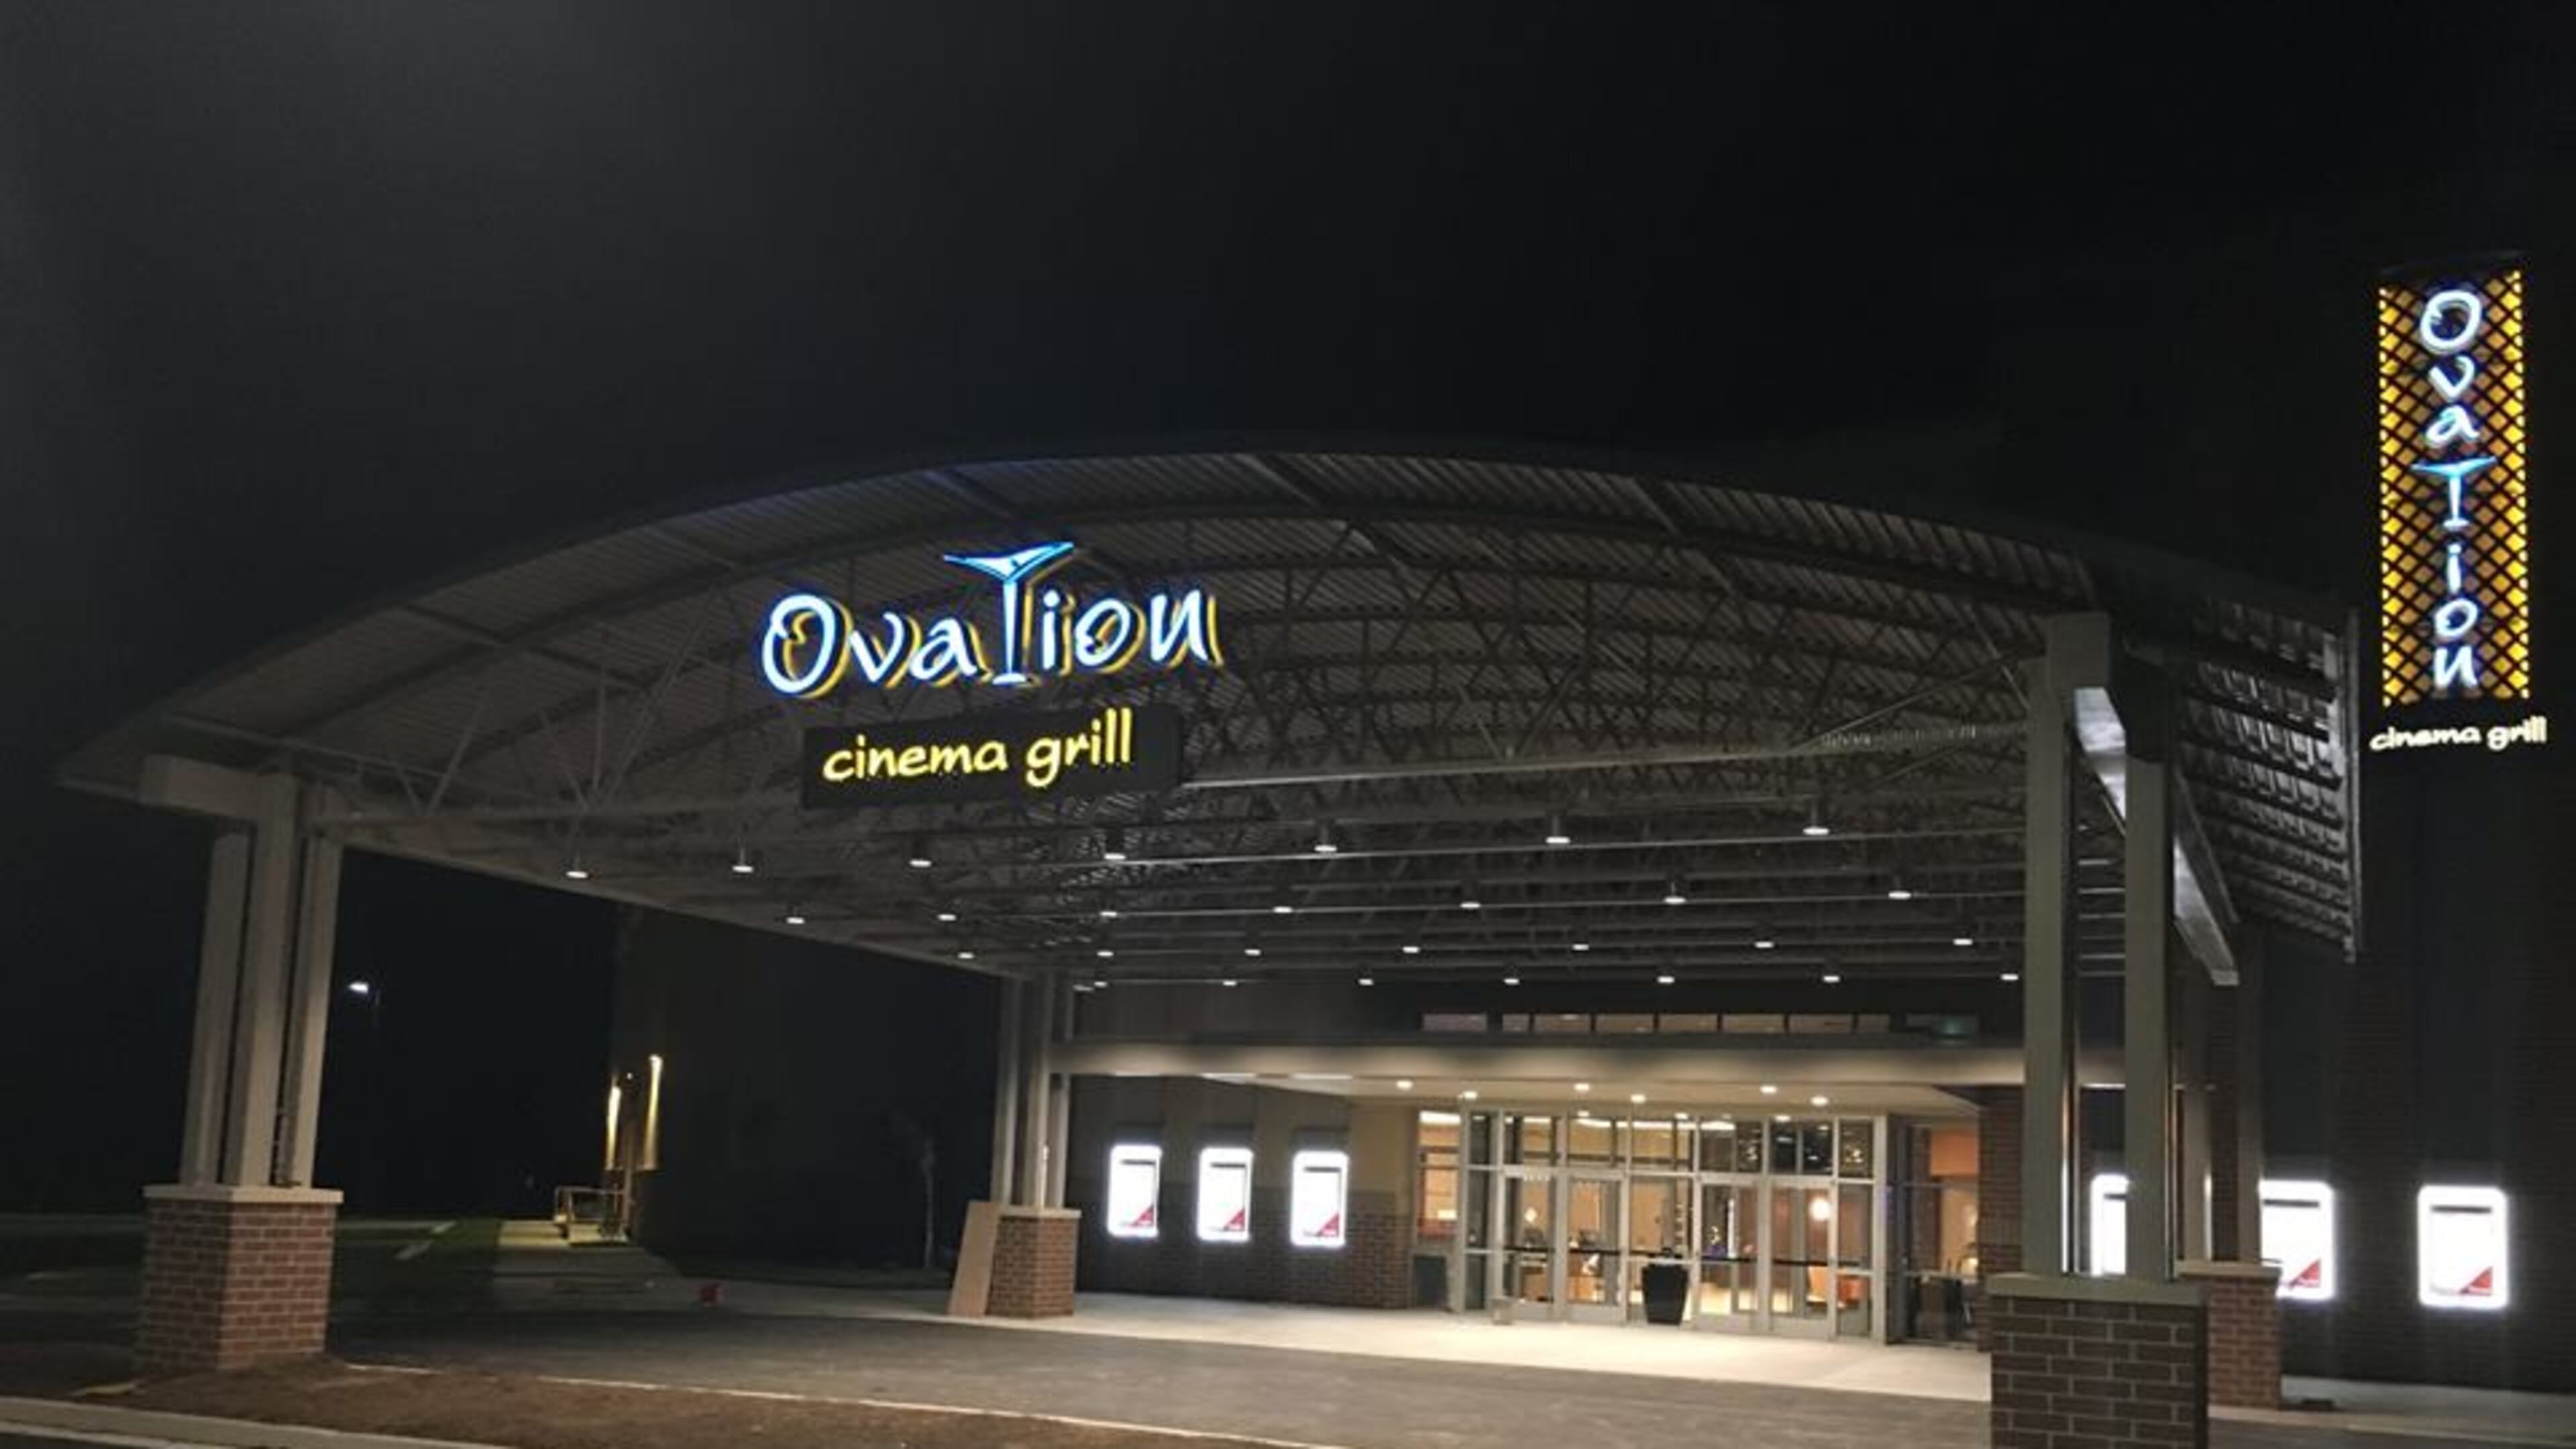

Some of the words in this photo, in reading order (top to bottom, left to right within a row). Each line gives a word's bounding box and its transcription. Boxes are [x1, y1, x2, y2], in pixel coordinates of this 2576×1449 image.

[823, 735, 1008, 781] cinema
[1026, 708, 1131, 787] grill
[2369, 727, 2481, 750] cinema
[2487, 716, 2546, 750] grill
